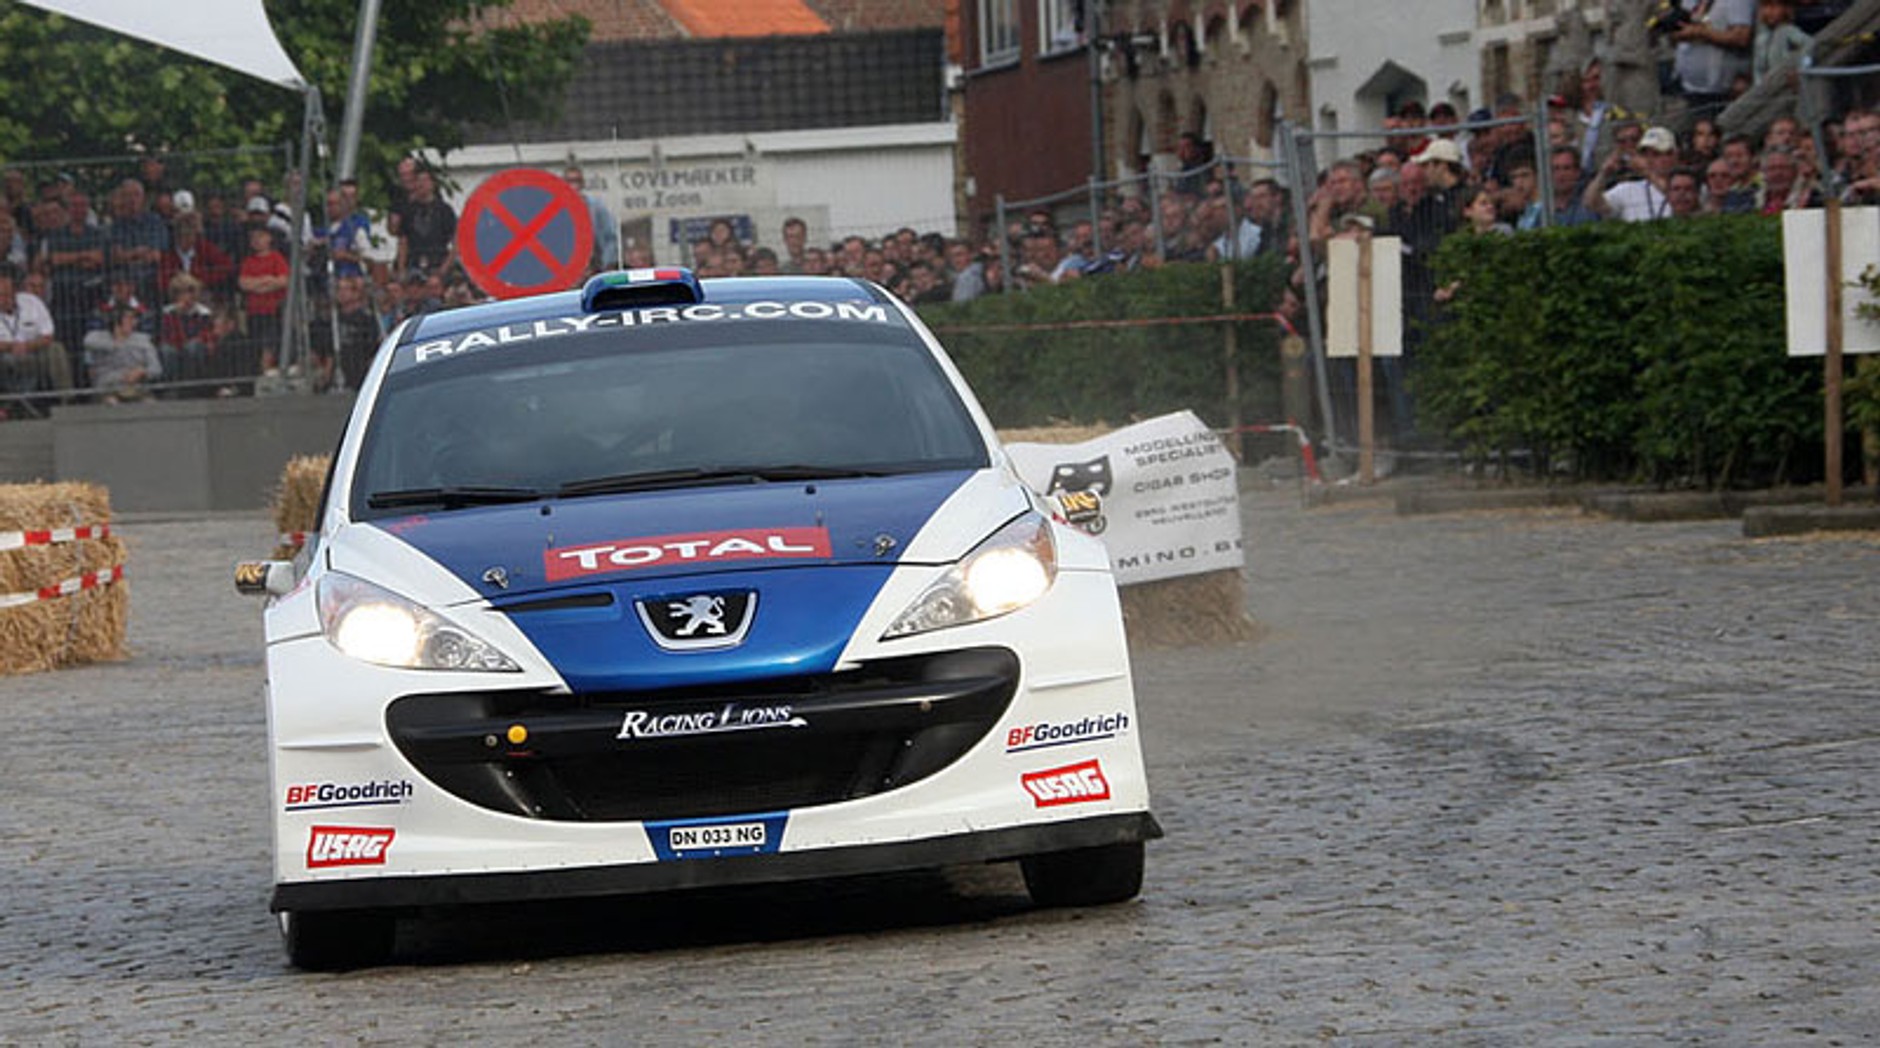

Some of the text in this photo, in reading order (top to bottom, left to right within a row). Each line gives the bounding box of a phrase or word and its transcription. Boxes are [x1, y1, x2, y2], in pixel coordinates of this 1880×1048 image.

[624, 190, 702, 210] en Zoon
[414, 301, 889, 364] RALLY-IRC.COM
[1133, 467, 1231, 493] CIGAR SHOP
[559, 535, 815, 570] TOTAL
[616, 710, 716, 740] RACING
[1007, 712, 1129, 746] BFGoodrich
[286, 780, 413, 804] BFGoodrich
[1024, 767, 1107, 801] USAG
[311, 833, 391, 861] USAG
[672, 826, 763, 845] DN 033 NG
